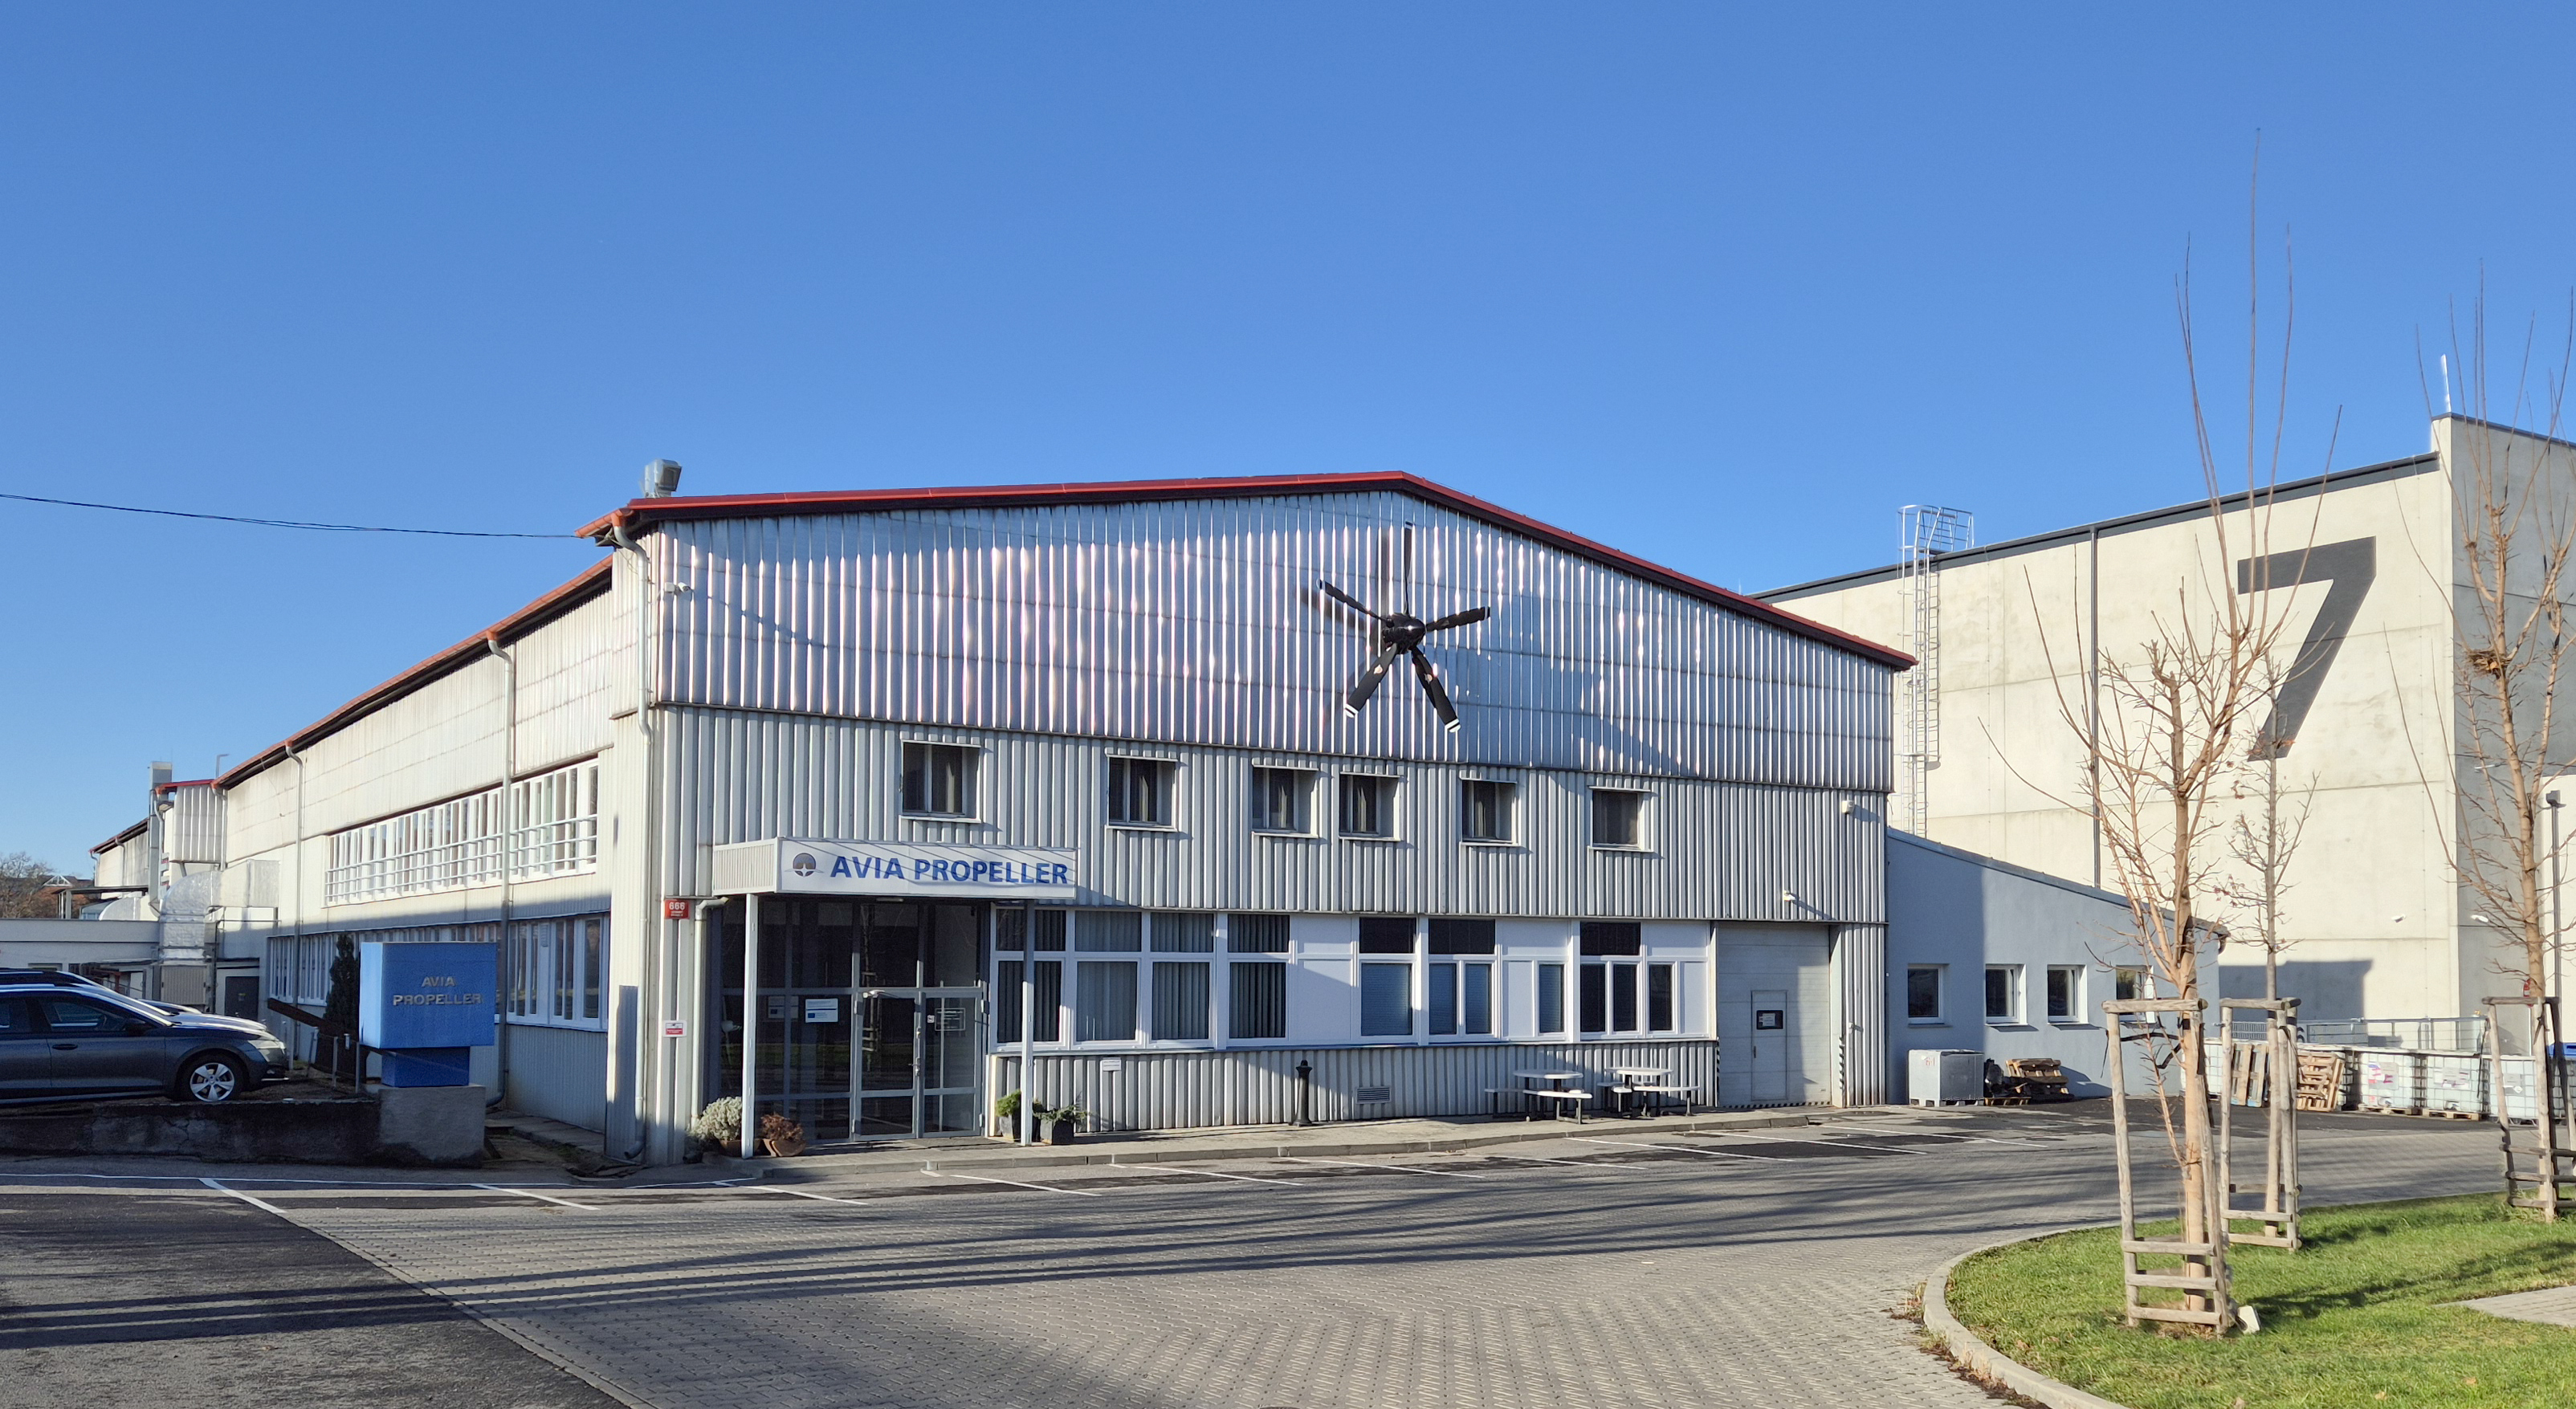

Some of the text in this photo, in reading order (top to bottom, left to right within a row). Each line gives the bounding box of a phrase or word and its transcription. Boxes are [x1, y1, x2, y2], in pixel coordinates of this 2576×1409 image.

[2237, 536, 2377, 762] 7
[830, 856, 1068, 884] AVIA PROPELLER
[422, 976, 456, 988] AVIA
[393, 993, 483, 1006] PROPELLER
